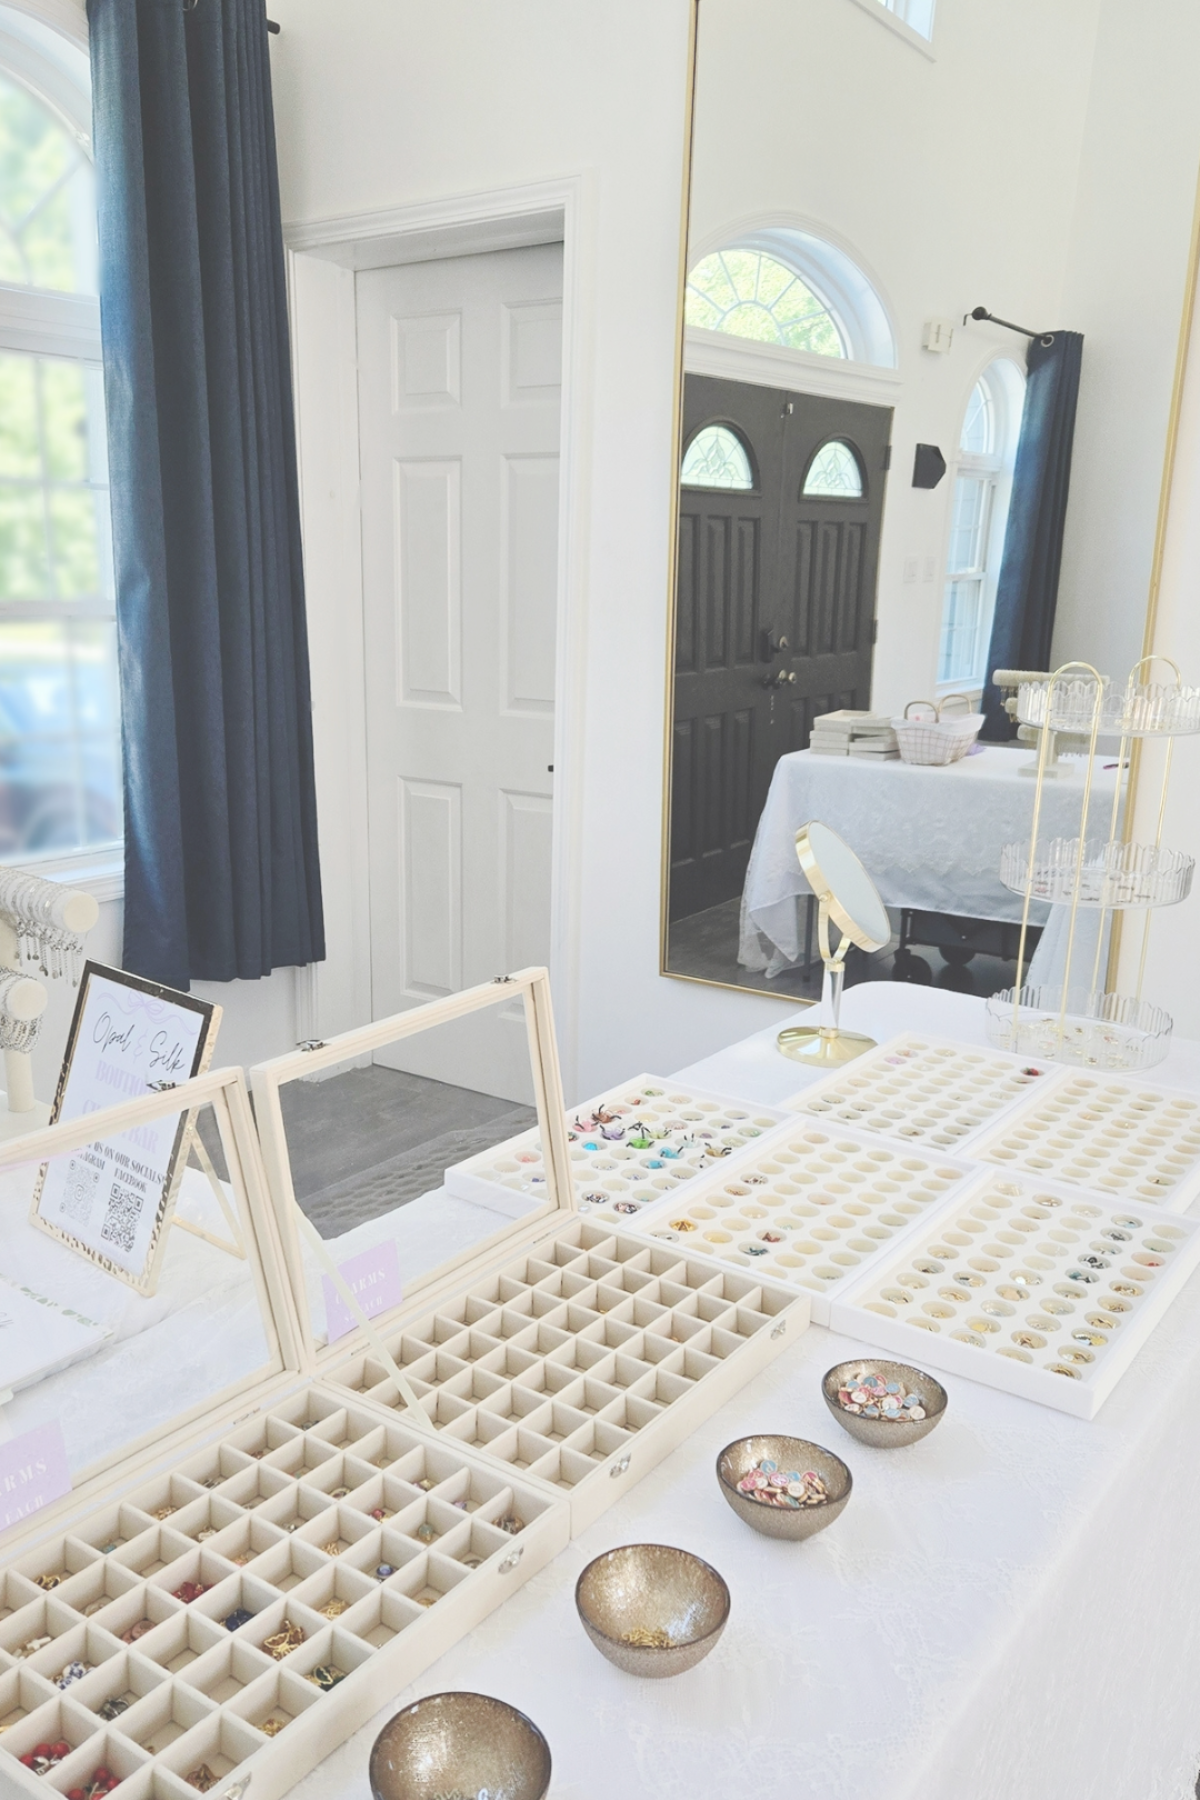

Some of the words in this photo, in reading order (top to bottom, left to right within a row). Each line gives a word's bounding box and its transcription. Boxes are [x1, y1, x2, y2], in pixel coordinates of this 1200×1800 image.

[93, 1011, 135, 1053] Opal
[149, 1030, 185, 1074] Silk
[104, 1146, 115, 1160] ON
[115, 1151, 130, 1168] OUR
[114, 1167, 148, 1193] FACEBOOK
